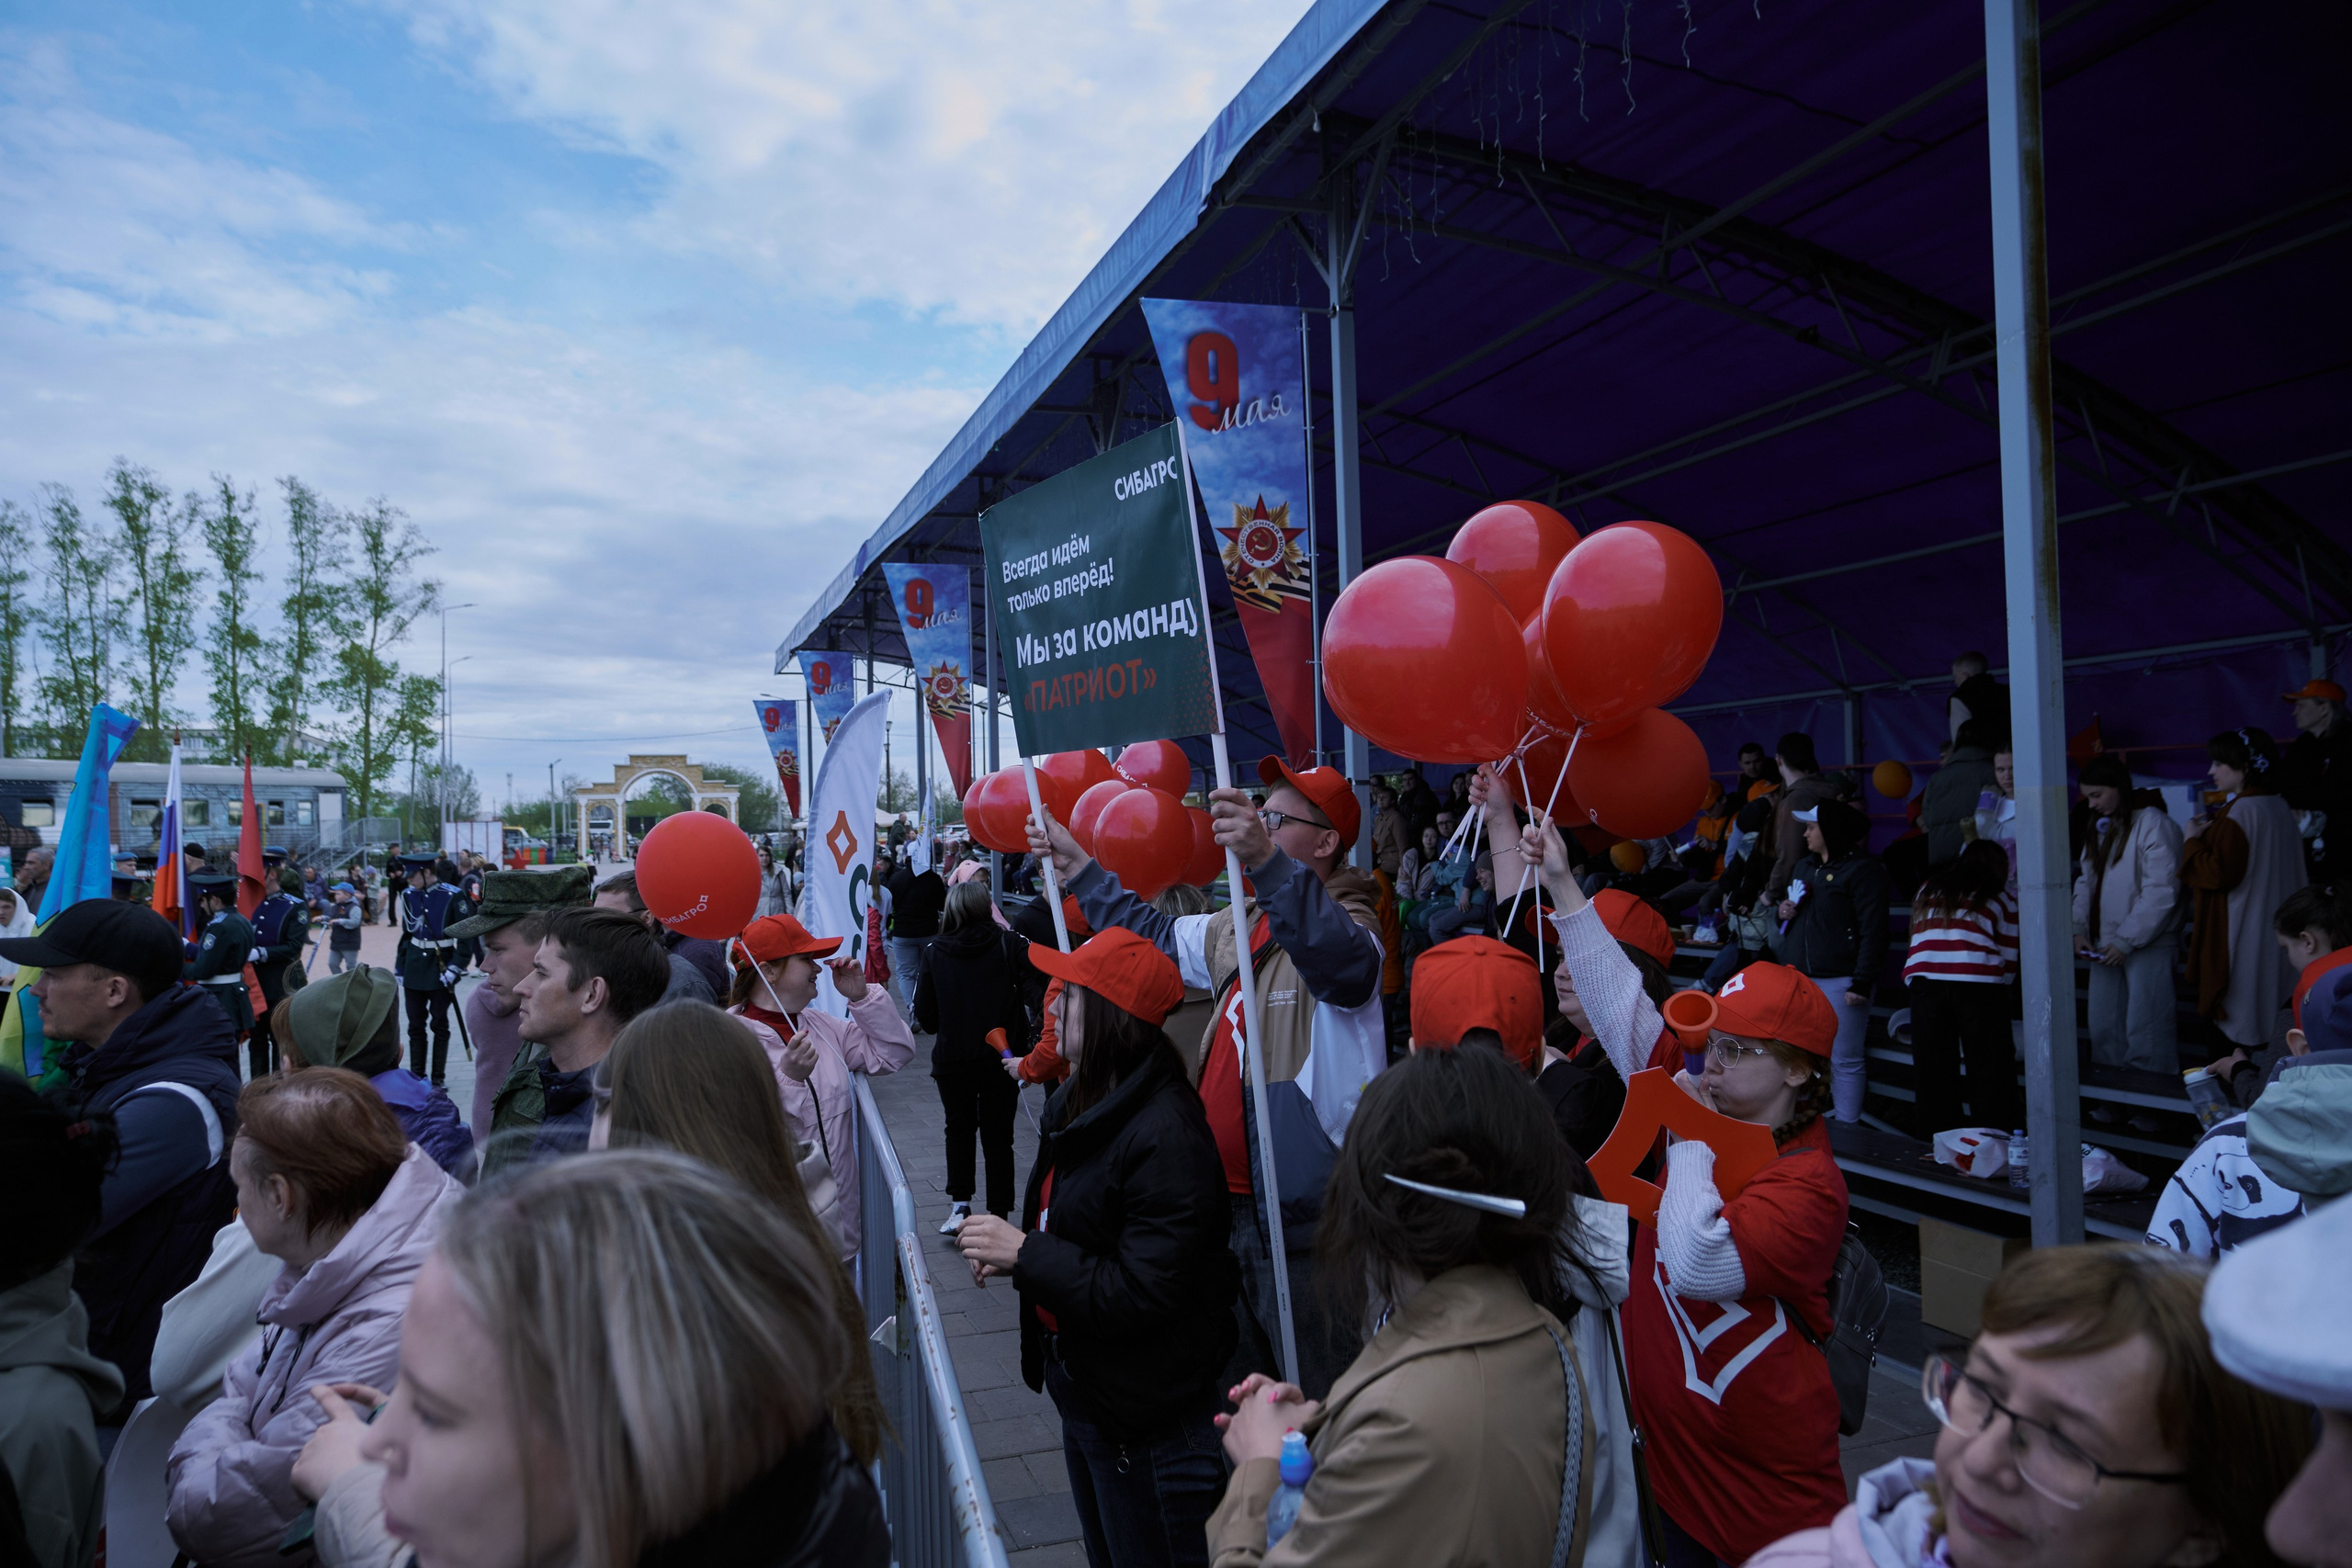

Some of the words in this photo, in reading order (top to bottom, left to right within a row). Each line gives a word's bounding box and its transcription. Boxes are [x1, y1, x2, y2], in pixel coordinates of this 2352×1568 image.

[1188, 332, 1239, 432] 9
[1212, 394, 1292, 434] мая
[1002, 549, 1048, 583] Всегда
[1051, 534, 1091, 567] идём
[906, 579, 933, 630] 9
[1008, 586, 1051, 614] только
[1054, 558, 1114, 599] вперёд!
[919, 609, 962, 631] мая
[1015, 633, 1050, 669] Мы
[1055, 629, 1077, 660] за
[1083, 597, 1197, 652] команду
[811, 661, 831, 694] 9
[1023, 659, 1157, 713] «ПАТРИОТ»
[765, 707, 780, 732] 9
[661, 903, 707, 924] СИБАГРО
